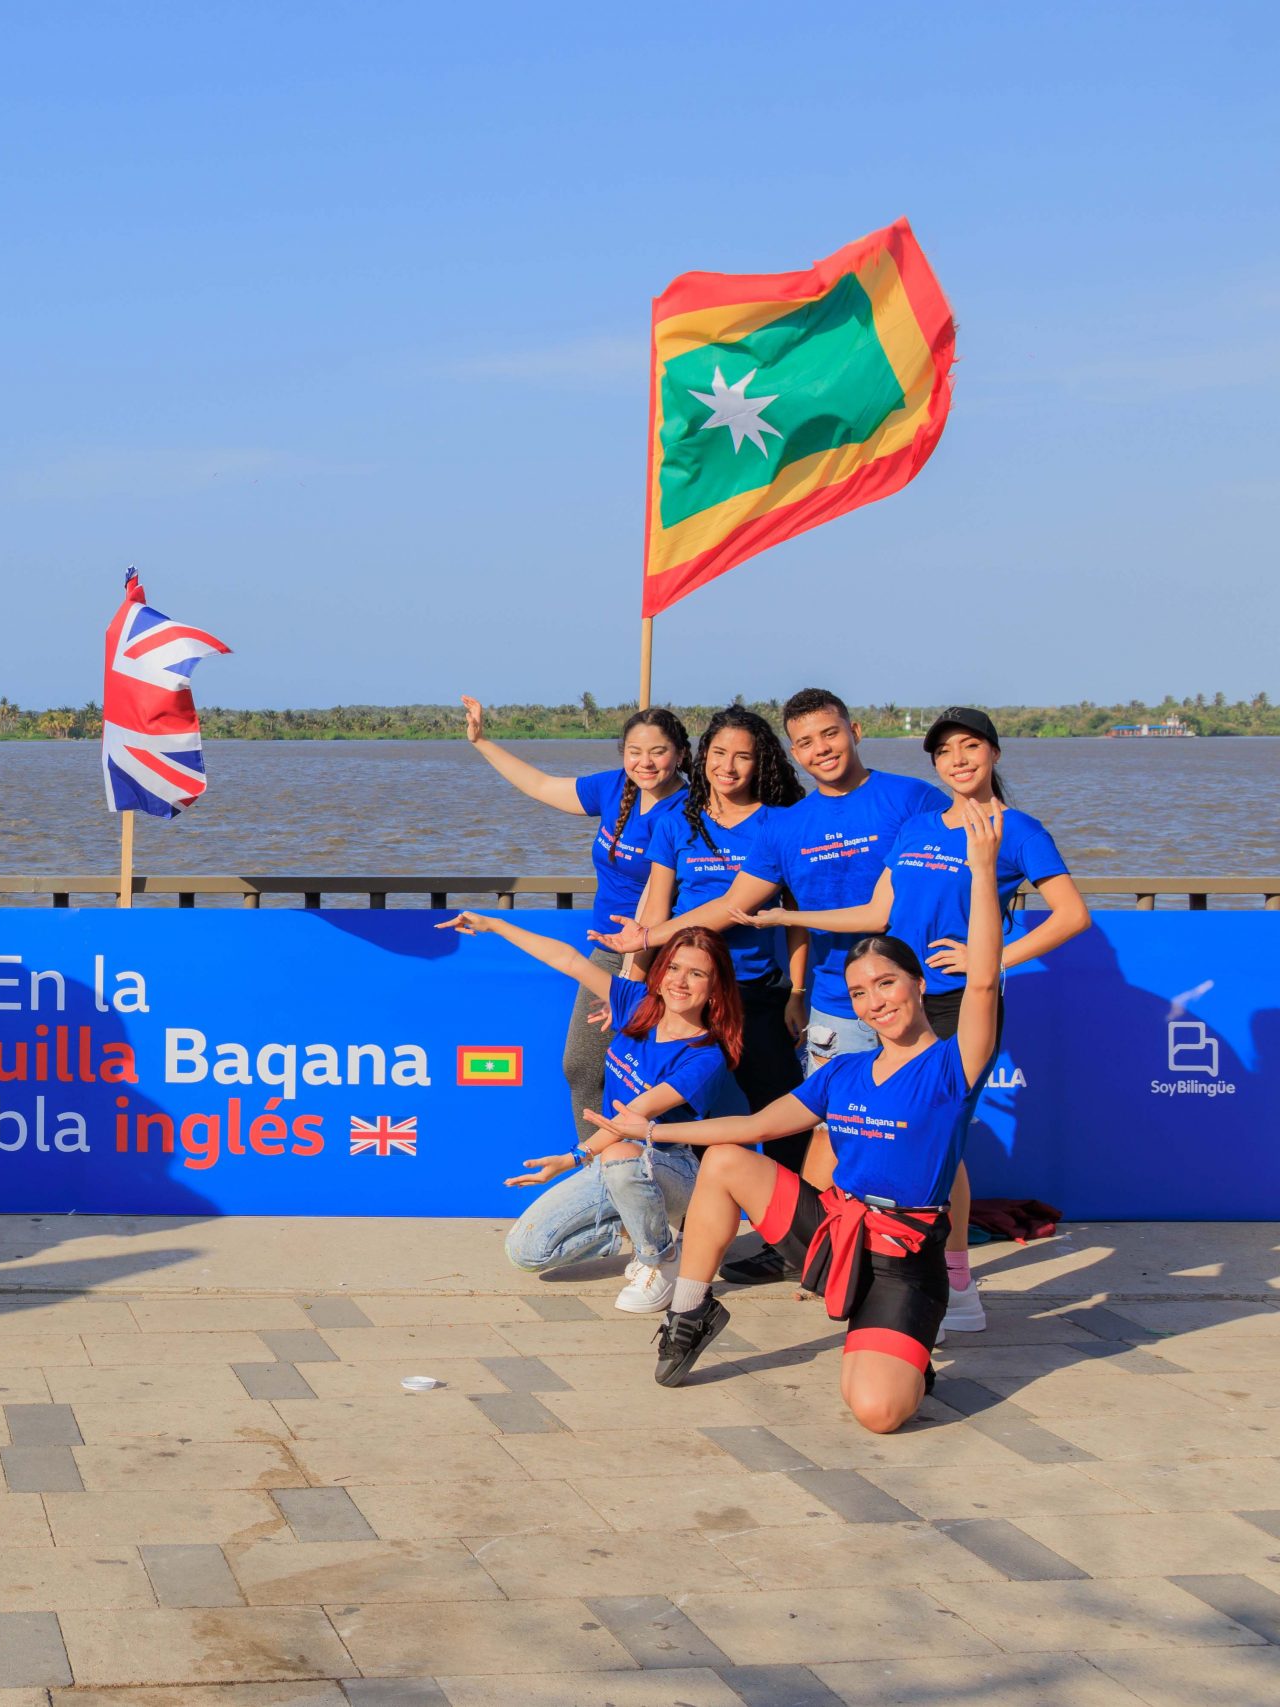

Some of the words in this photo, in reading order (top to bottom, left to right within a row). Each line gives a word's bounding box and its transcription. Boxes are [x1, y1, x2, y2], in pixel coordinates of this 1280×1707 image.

[844, 837, 868, 846] Baqana
[819, 852, 839, 861] habla
[935, 854, 963, 864] Baqana
[904, 859, 924, 867] habla
[96, 955, 150, 1014] la
[166, 1028, 431, 1100] Baqana
[848, 1103, 859, 1111] En
[859, 1104, 867, 1112] la
[865, 1116, 895, 1127] Baqana
[117, 1097, 324, 1171] inglés
[838, 1125, 859, 1135] habla
[860, 1128, 883, 1139] inglés
